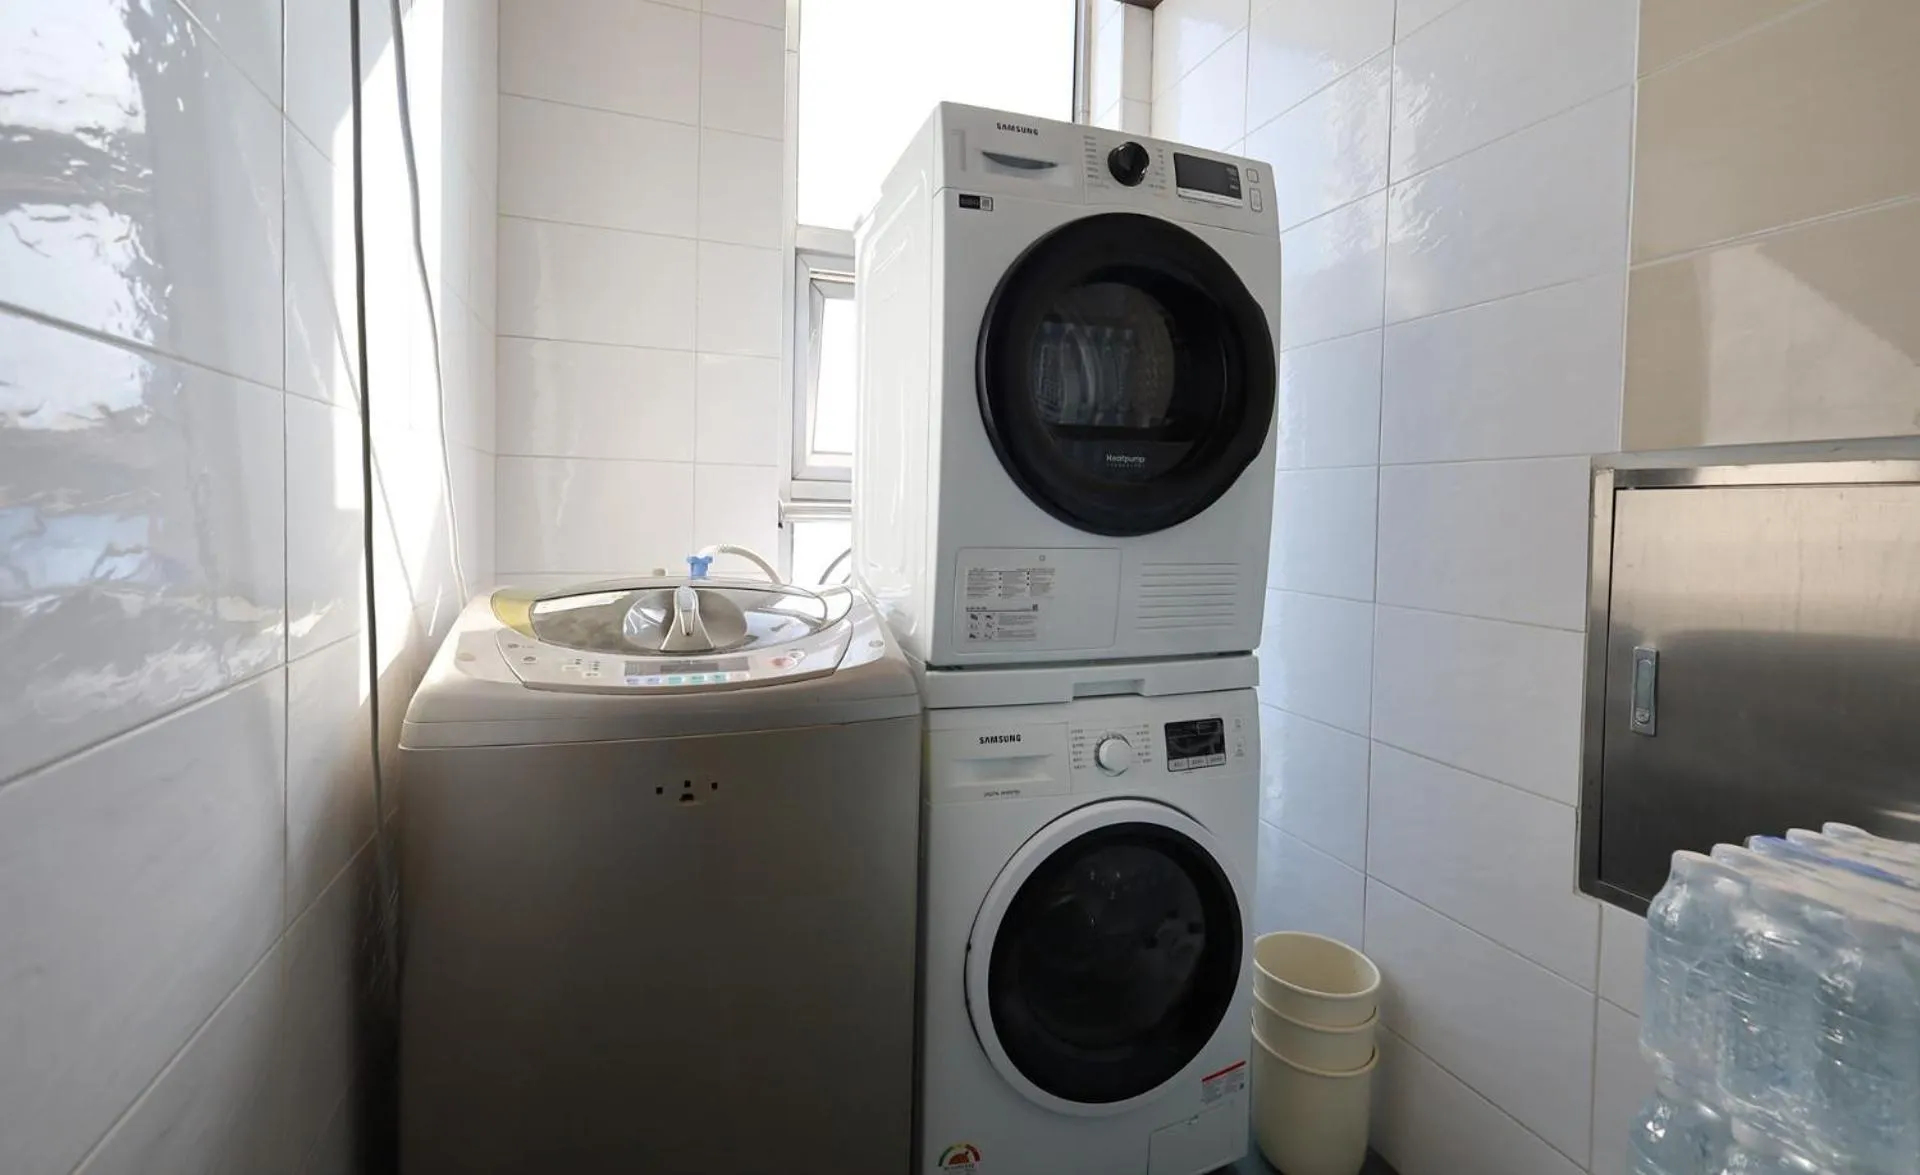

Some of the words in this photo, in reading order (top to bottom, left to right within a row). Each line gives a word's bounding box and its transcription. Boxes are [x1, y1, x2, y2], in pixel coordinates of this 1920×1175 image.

[996, 122, 1039, 136] SAMSUNG
[1106, 453, 1145, 464] Heatpump
[979, 734, 1021, 745] SAMSUNG
